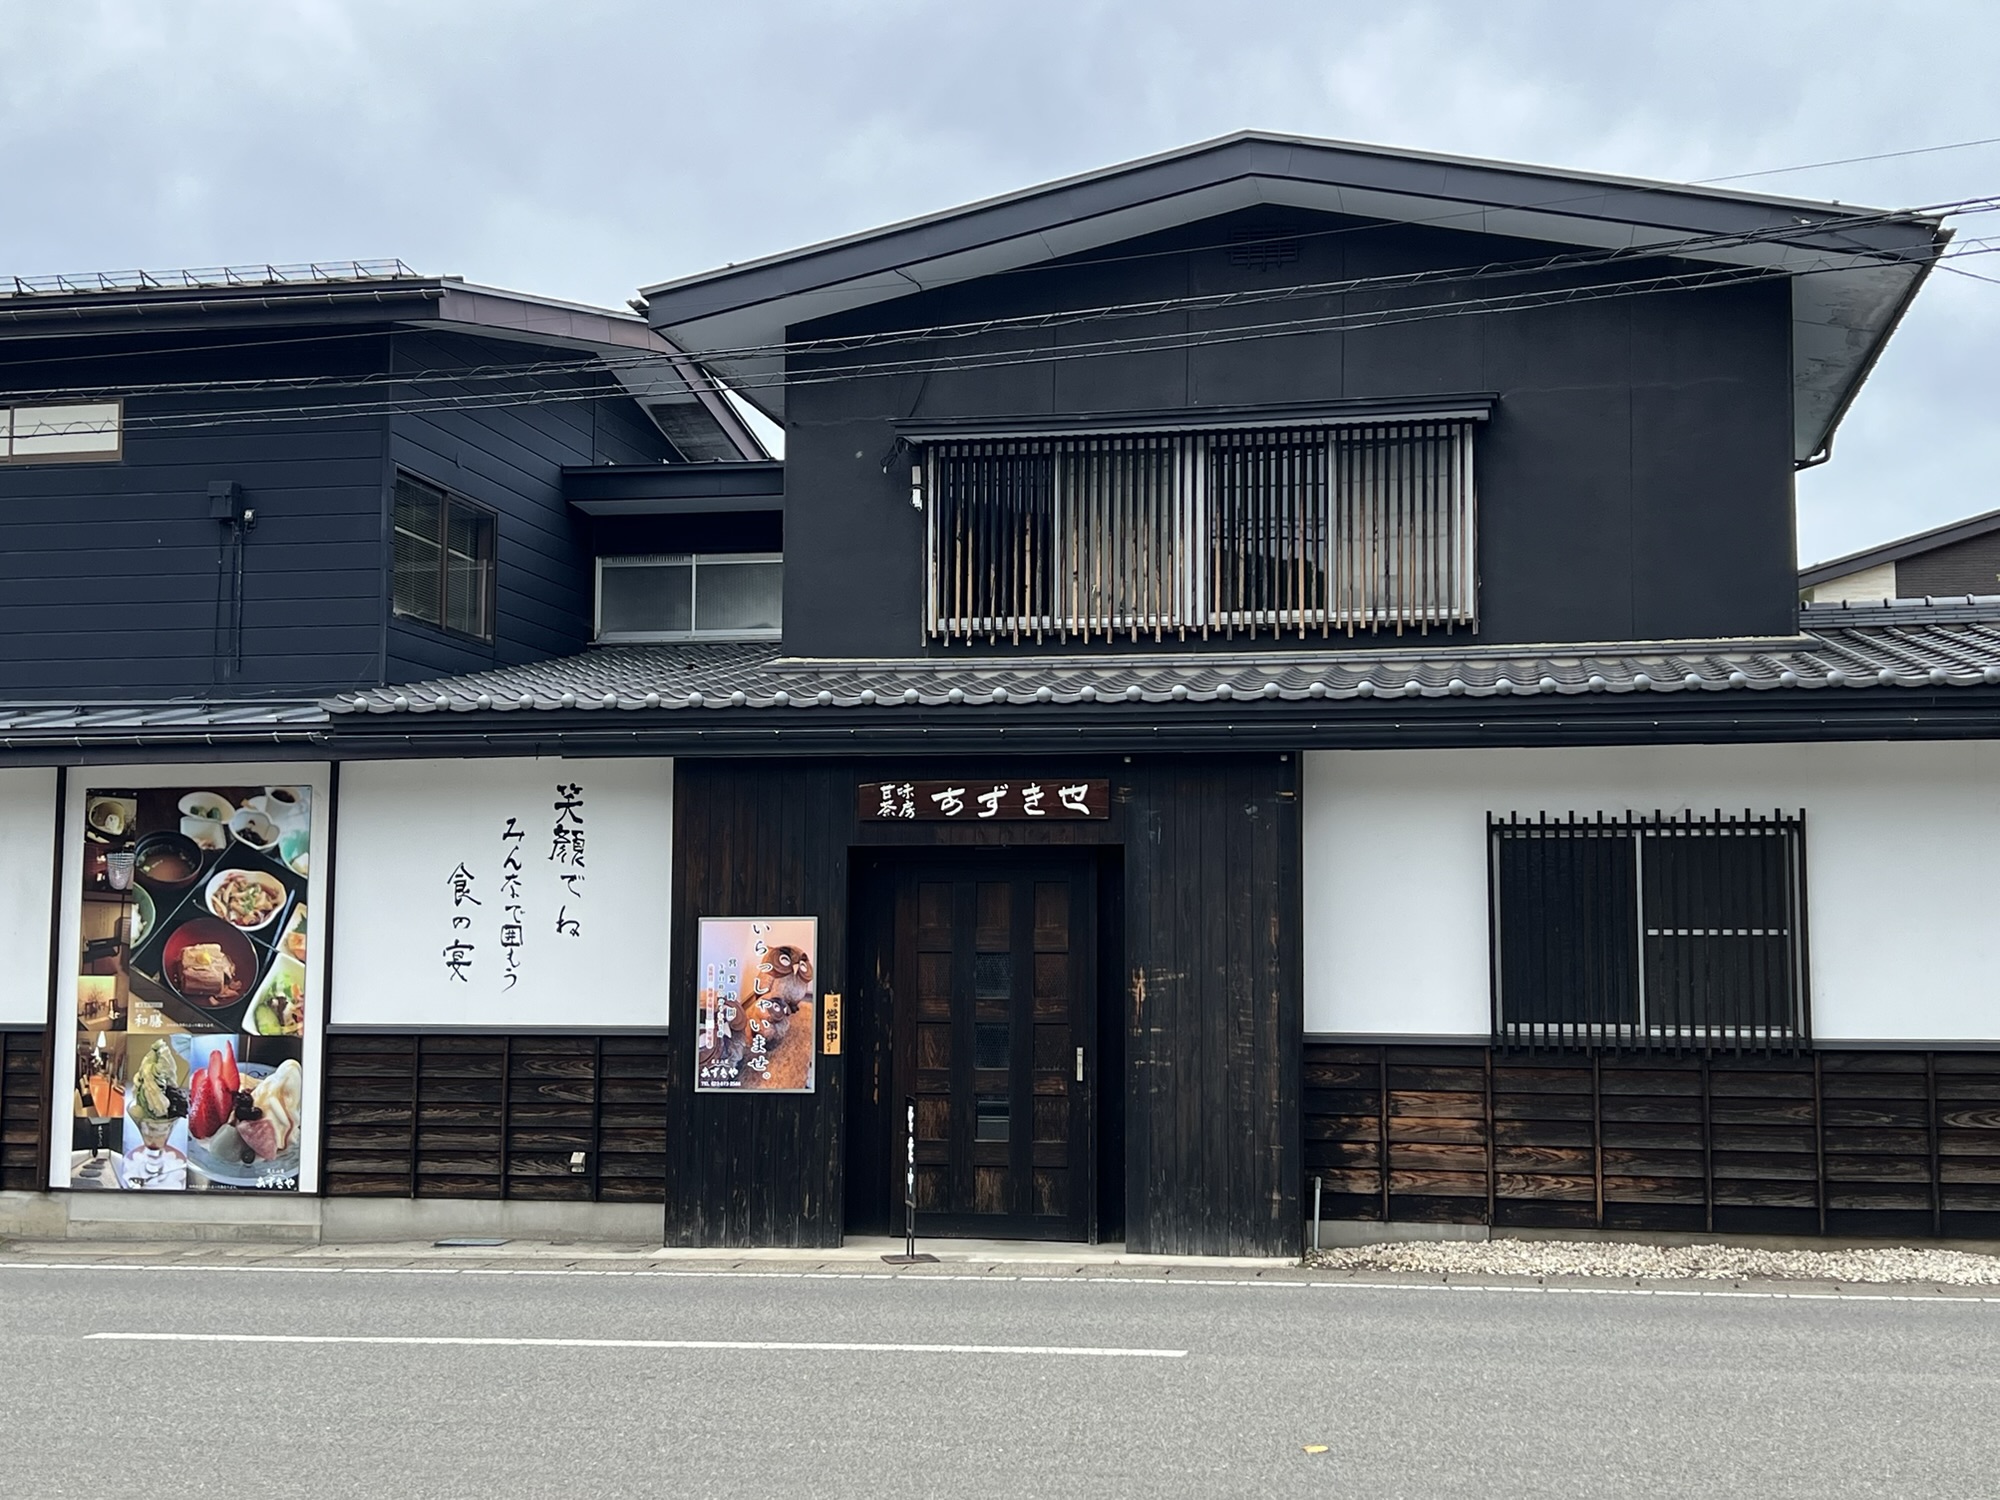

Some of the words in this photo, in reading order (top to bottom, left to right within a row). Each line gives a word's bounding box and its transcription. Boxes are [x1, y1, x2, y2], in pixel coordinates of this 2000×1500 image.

[879, 783, 915, 799] 甘味
[877, 800, 916, 819] 茶房
[548, 782, 586, 937] 笑顔でね
[500, 817, 526, 993] みんなで囲もう
[443, 862, 482, 982] 食の宴
[134, 1014, 163, 1028] 和膳
[826, 1009, 838, 1043] 営業中
[700, 1065, 739, 1079] あずきや
[255, 1176, 296, 1189] あずきや
